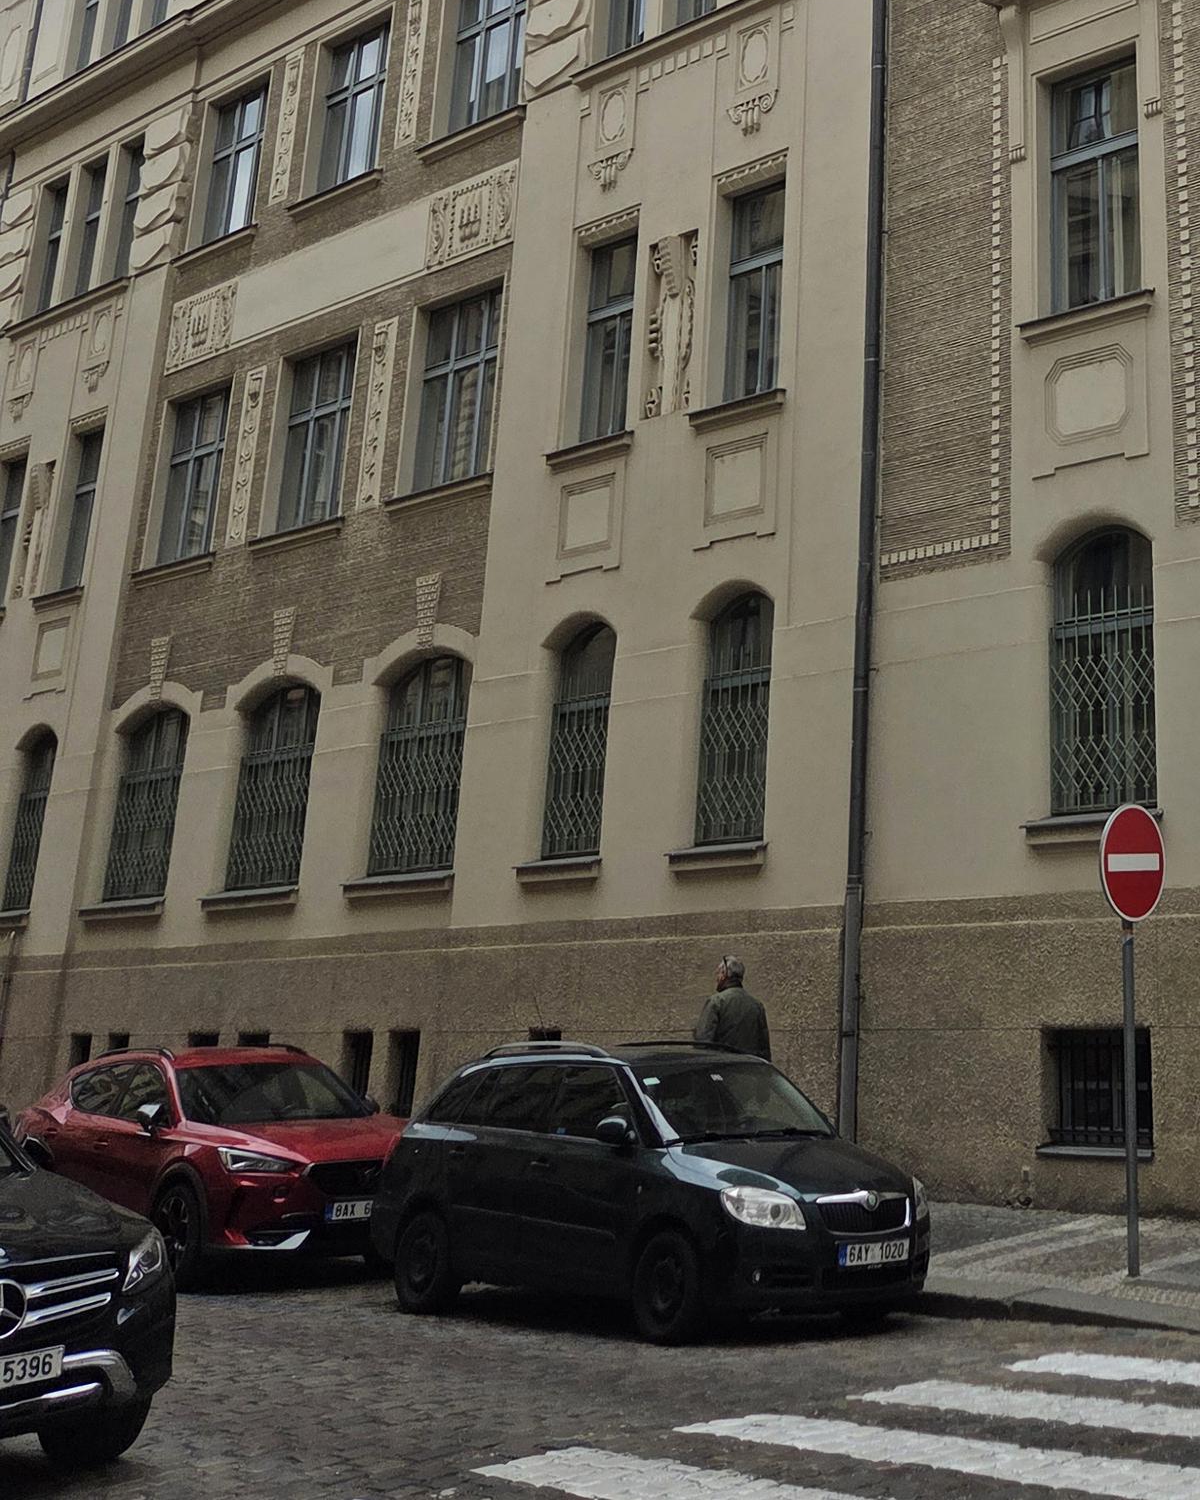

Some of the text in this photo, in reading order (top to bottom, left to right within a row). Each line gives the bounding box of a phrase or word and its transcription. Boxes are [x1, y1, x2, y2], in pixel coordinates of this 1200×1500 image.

[849, 1242, 904, 1263] 6AY 1020
[3, 1353, 53, 1383] 5396
